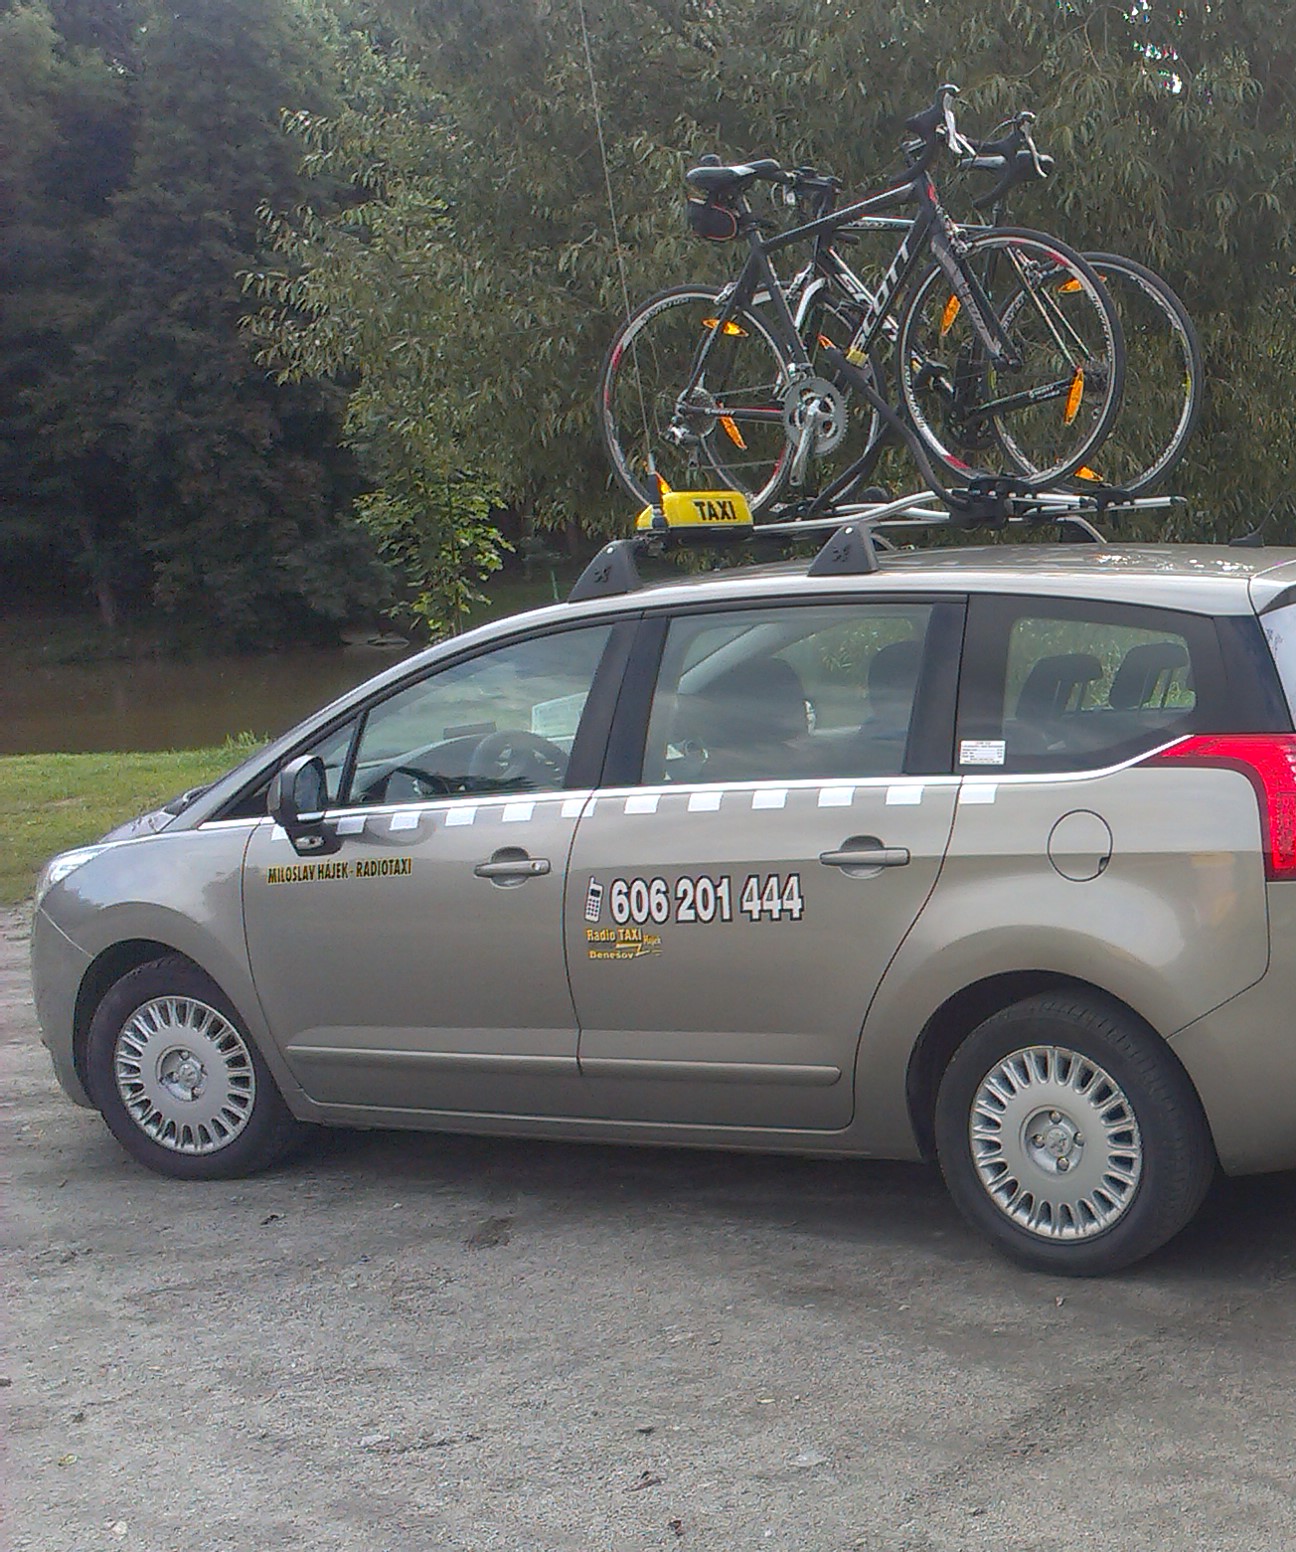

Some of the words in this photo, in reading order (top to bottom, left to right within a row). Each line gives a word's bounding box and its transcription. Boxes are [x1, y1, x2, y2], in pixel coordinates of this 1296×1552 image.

[693, 500, 737, 521] TAXI
[267, 864, 316, 884] MILOSLAV
[317, 859, 348, 880] HÁJEK
[356, 858, 412, 877] RADIOTAXI
[610, 876, 669, 925] 606
[674, 875, 732, 923] 201
[740, 873, 804, 922] 444
[585, 928, 617, 942] Radio
[617, 927, 643, 942] TAXI
